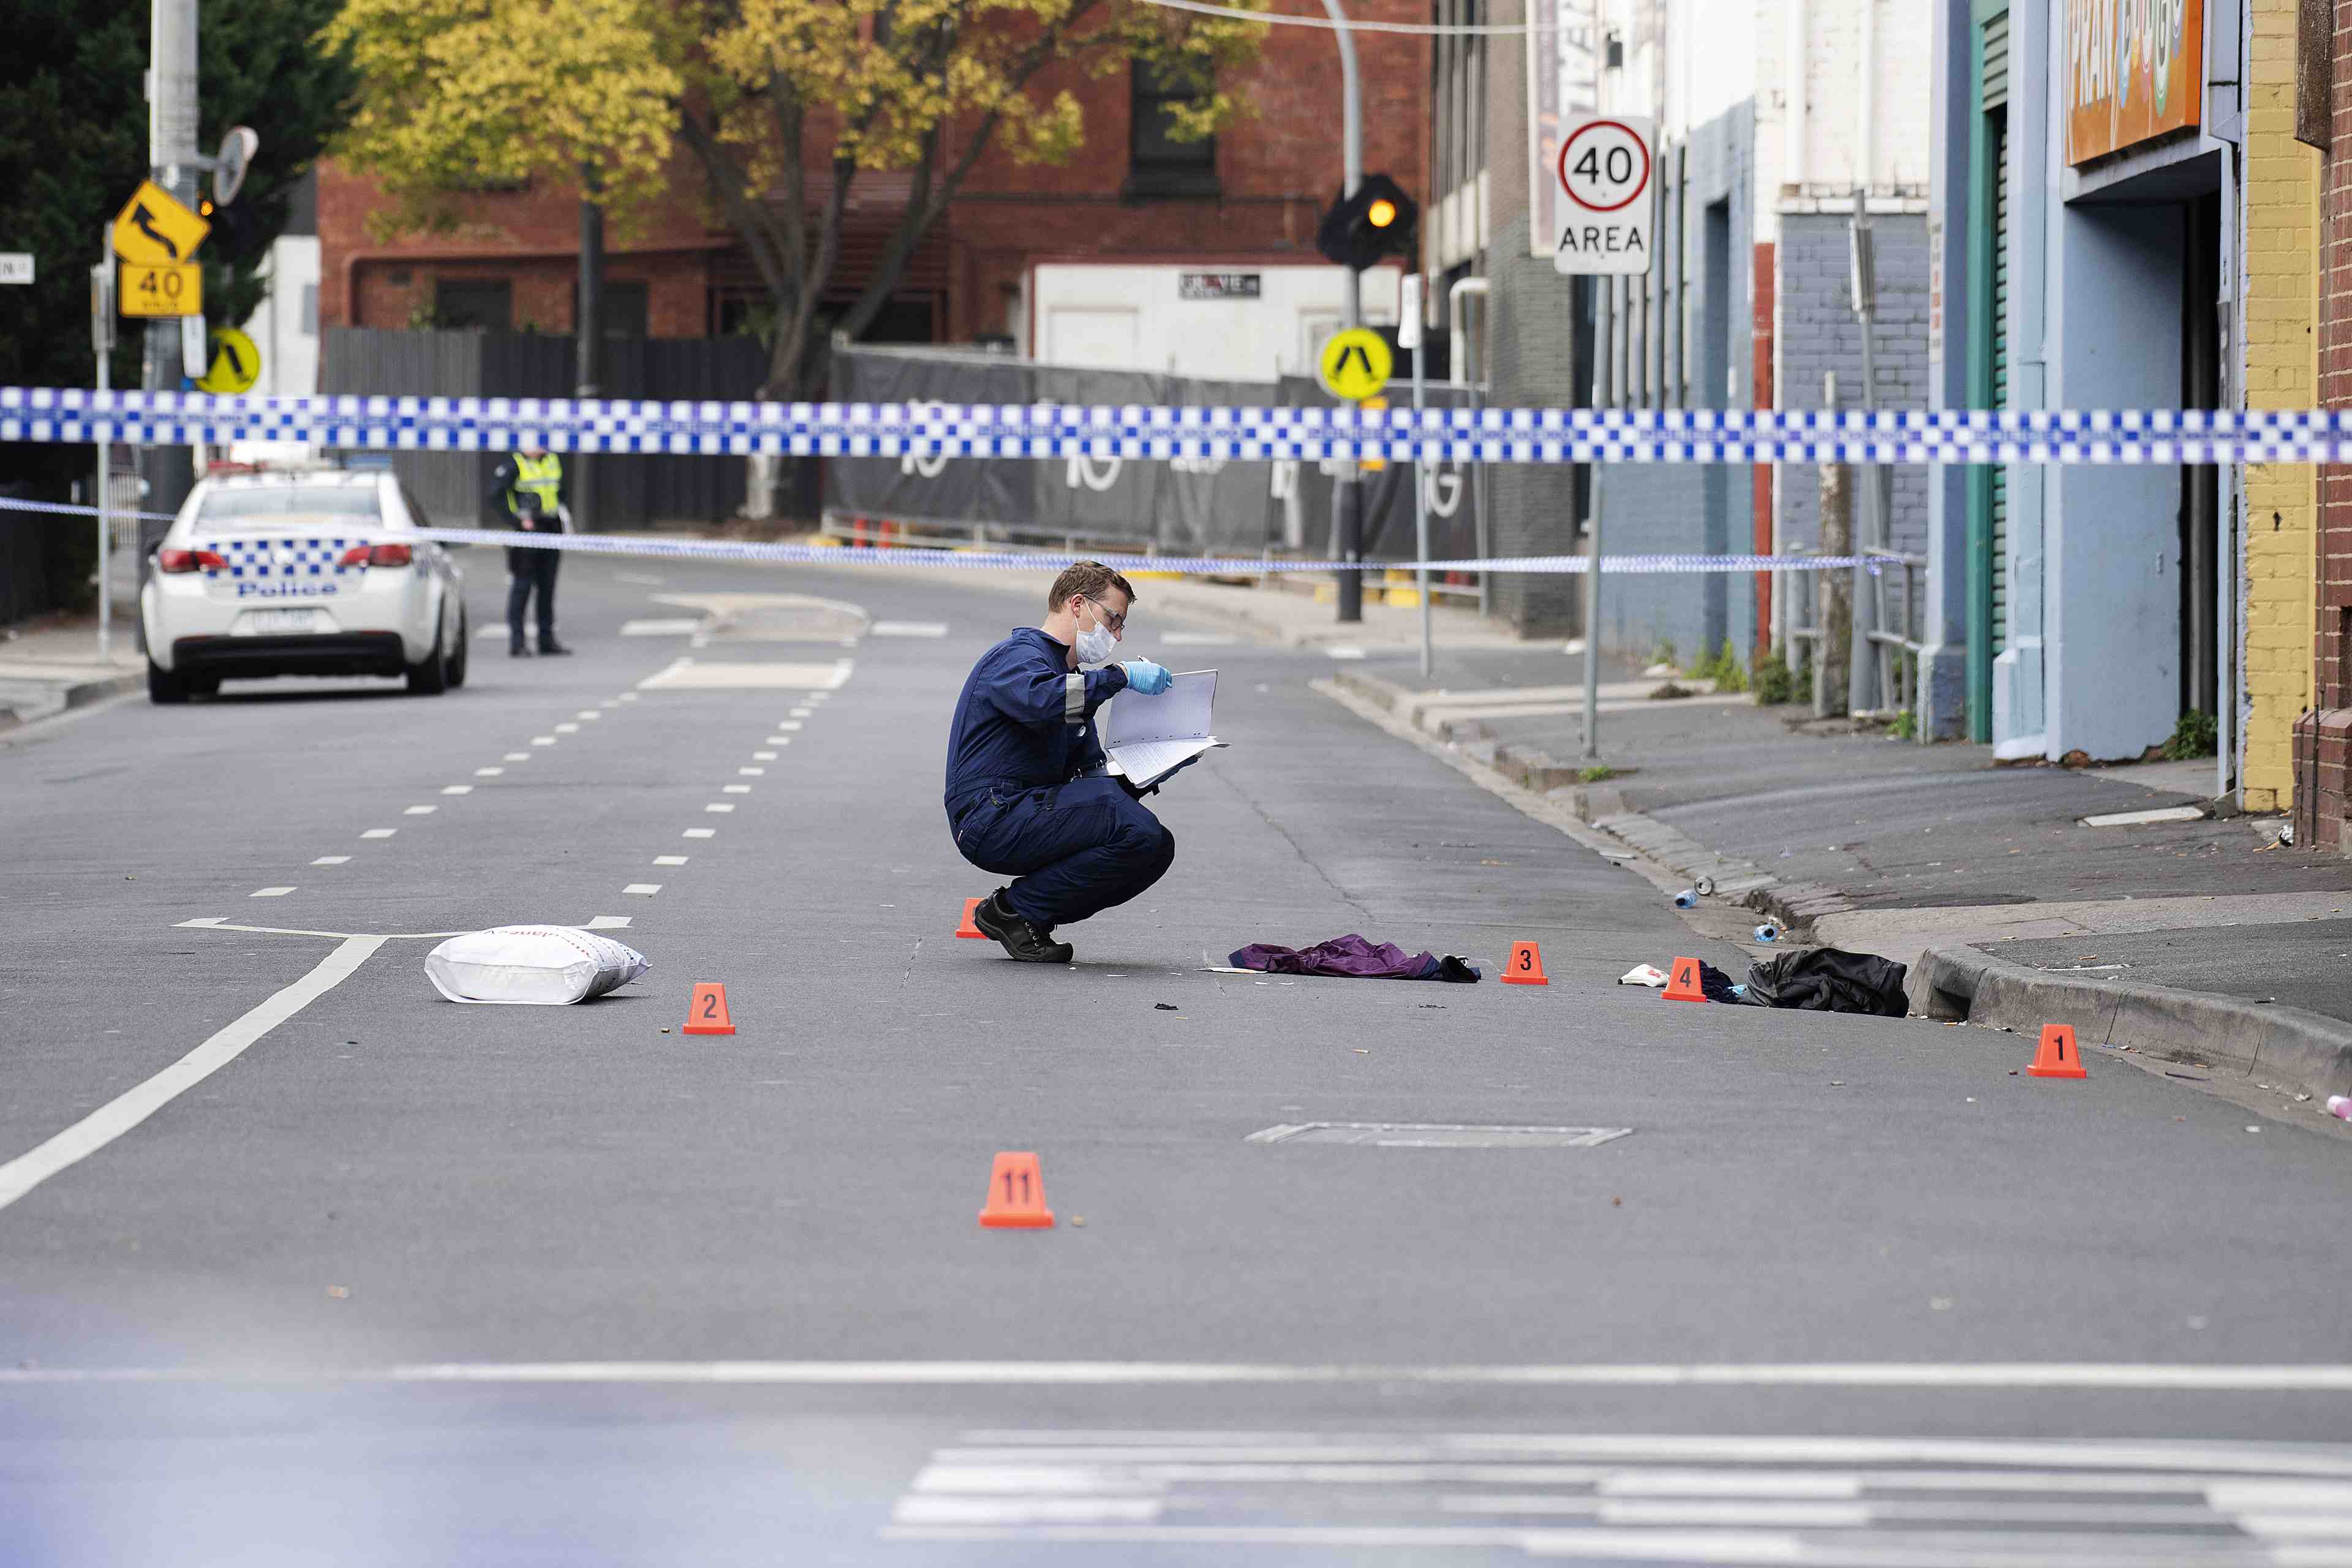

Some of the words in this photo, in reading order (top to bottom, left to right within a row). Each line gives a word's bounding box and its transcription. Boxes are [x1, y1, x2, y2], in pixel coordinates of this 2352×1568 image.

[1574, 146, 1632, 184] 40
[1559, 226, 1644, 252] AREA
[139, 271, 183, 298] 40
[238, 582, 337, 598] Police
[1520, 949, 1532, 971] 3
[1679, 966, 1692, 988] 4
[704, 993, 717, 1019] 2
[2054, 1035, 2064, 1061] 1
[1003, 1170, 1030, 1205] 11
